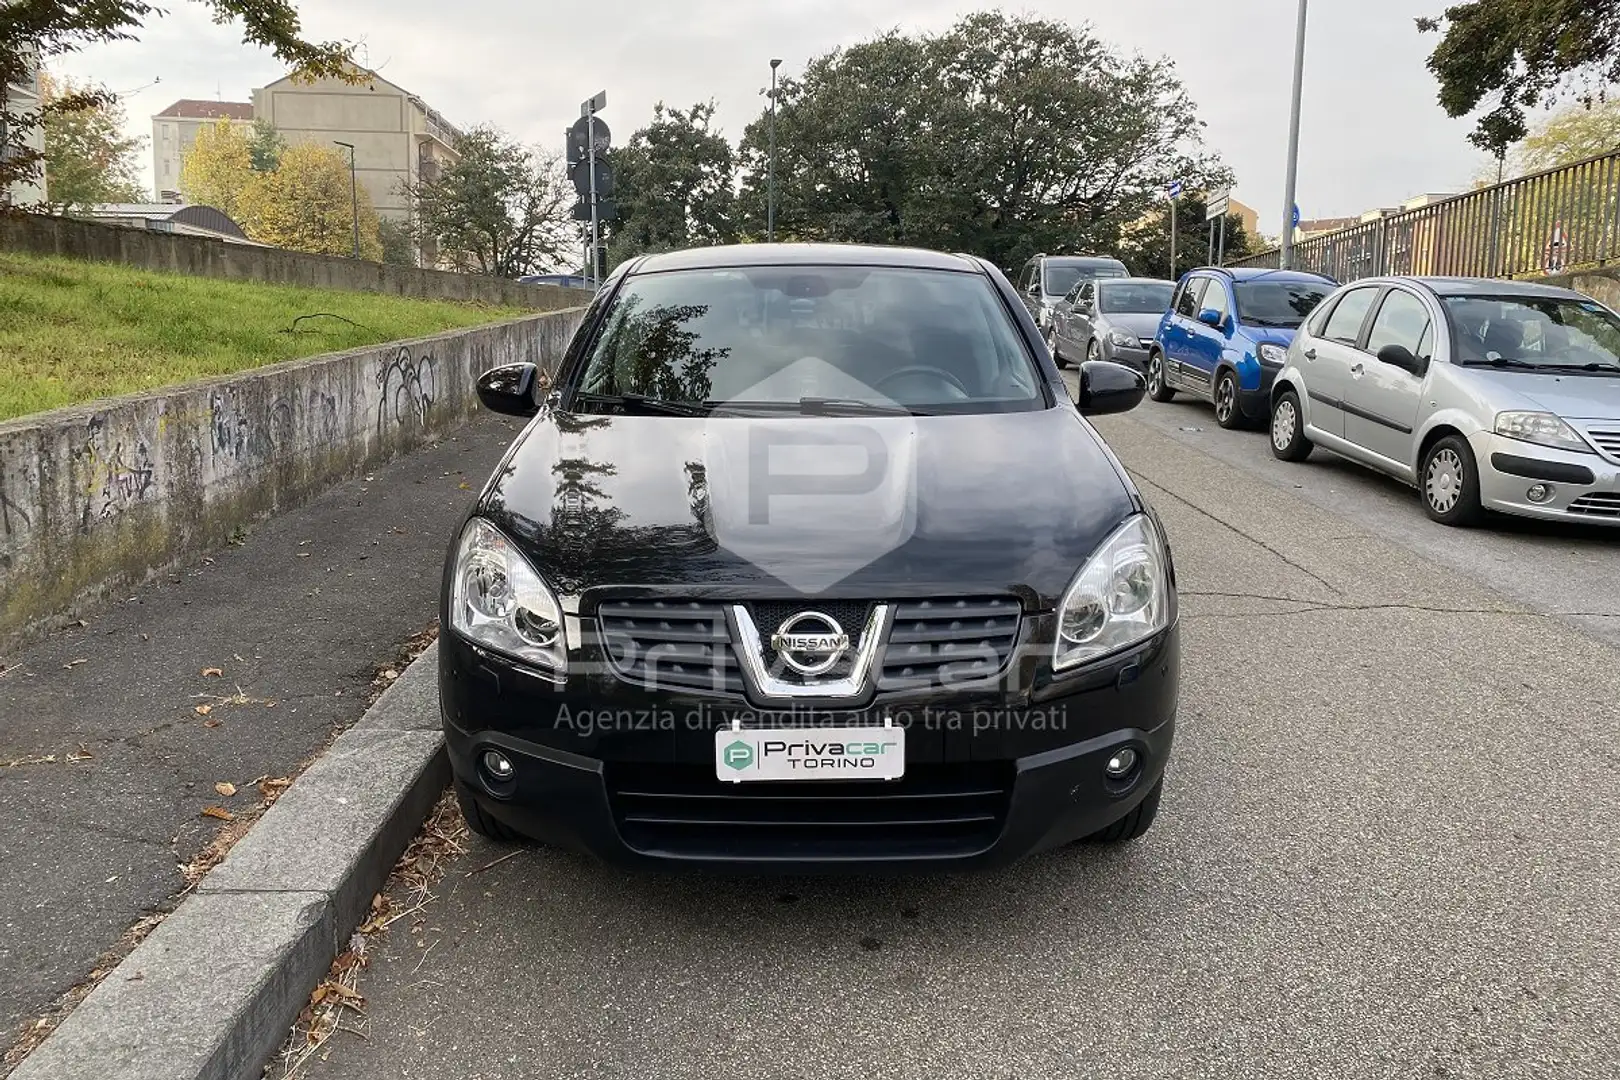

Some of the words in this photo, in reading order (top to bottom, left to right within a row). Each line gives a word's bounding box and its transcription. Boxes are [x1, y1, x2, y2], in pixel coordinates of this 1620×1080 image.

[779, 637, 841, 649] NISSAN
[764, 740, 897, 756] Privacar
[787, 758, 876, 768] TORINO
